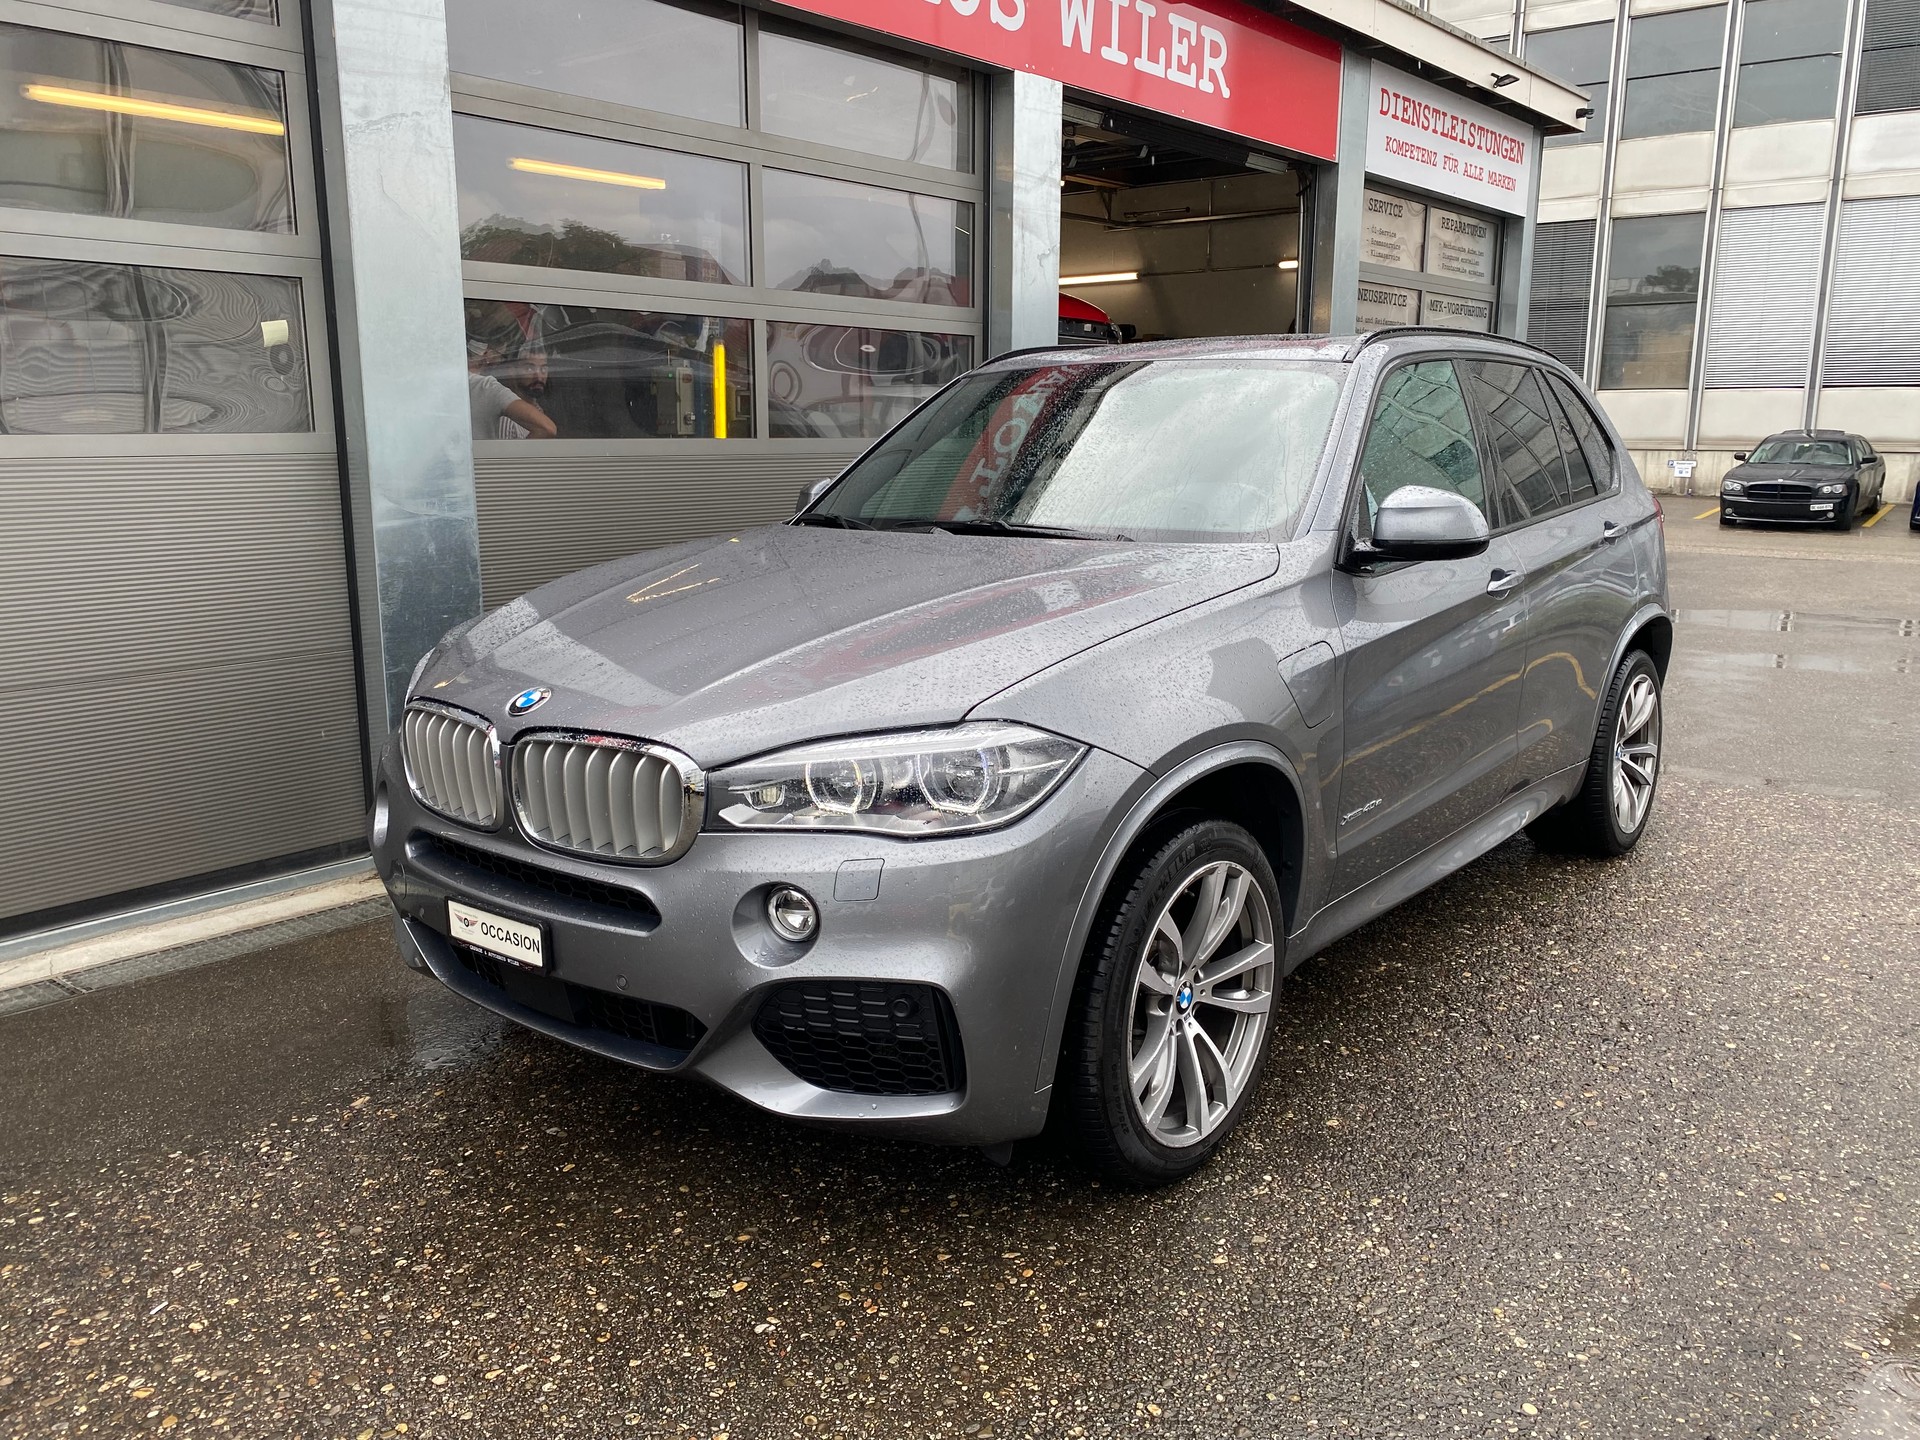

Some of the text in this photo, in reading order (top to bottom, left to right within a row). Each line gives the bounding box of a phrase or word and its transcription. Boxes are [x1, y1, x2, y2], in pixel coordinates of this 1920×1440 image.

[1062, 0, 1230, 98] WILER
[1379, 88, 1525, 165] DIENSTLEISTUNGEN
[1385, 136, 1517, 193] KOMPETENZ FÜR ALLE MARKEN
[1368, 197, 1404, 218] SERVICE
[1441, 216, 1487, 239] REPARATUREN
[1358, 288, 1408, 307] NEUSERVICE
[480, 922, 540, 953] OCCASION
